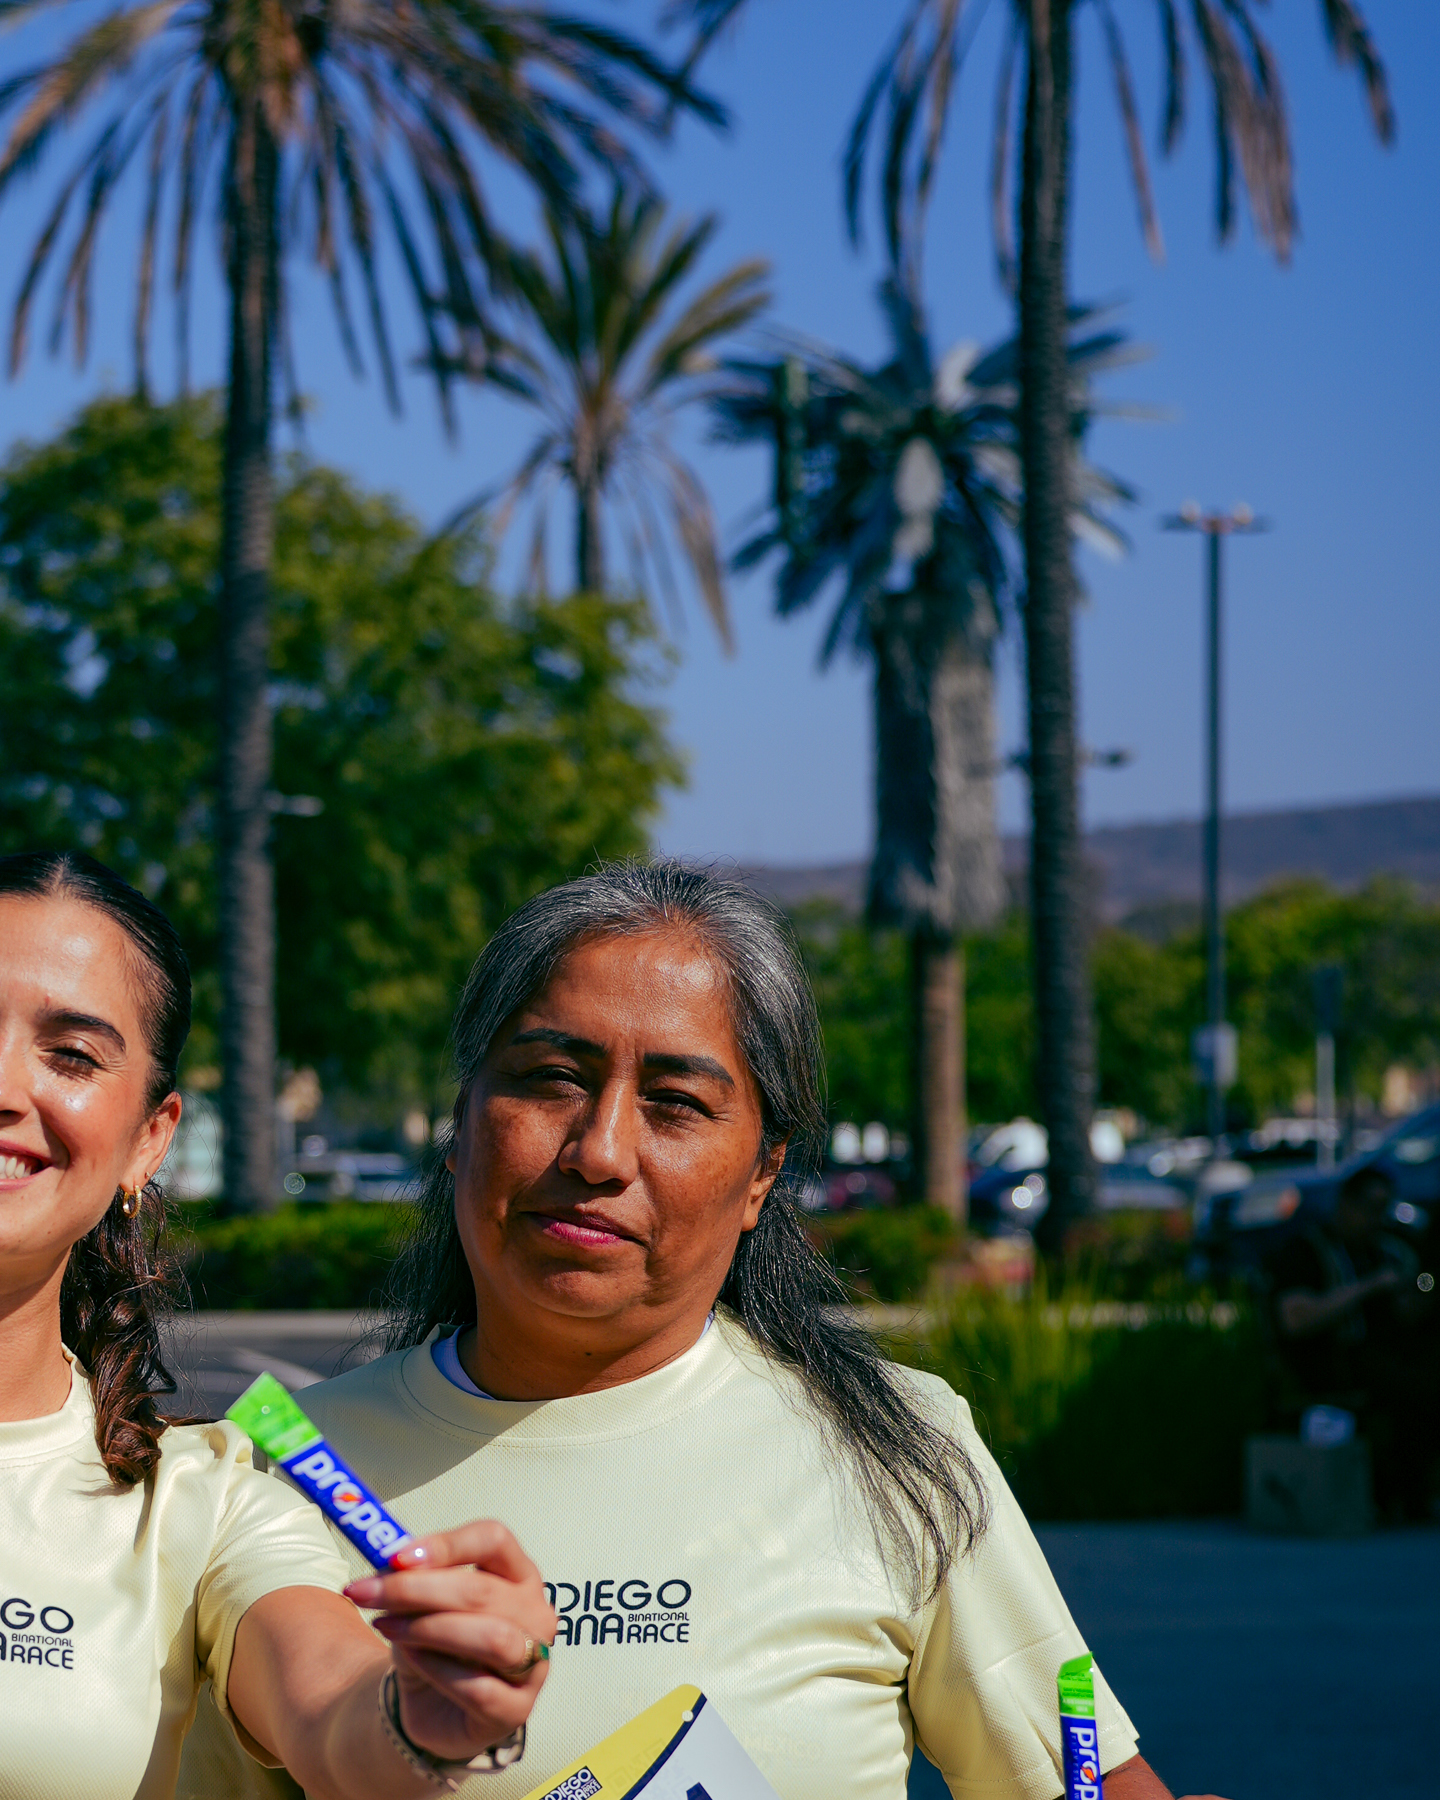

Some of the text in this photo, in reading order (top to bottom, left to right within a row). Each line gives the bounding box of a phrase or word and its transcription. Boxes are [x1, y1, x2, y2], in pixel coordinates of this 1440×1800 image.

[291, 1449, 412, 1559] propel
[627, 1612, 690, 1622] BINATIONAL
[11, 1633, 74, 1648] BINATIONAL
[627, 1623, 690, 1643] RACE
[11, 1644, 74, 1670] RACE
